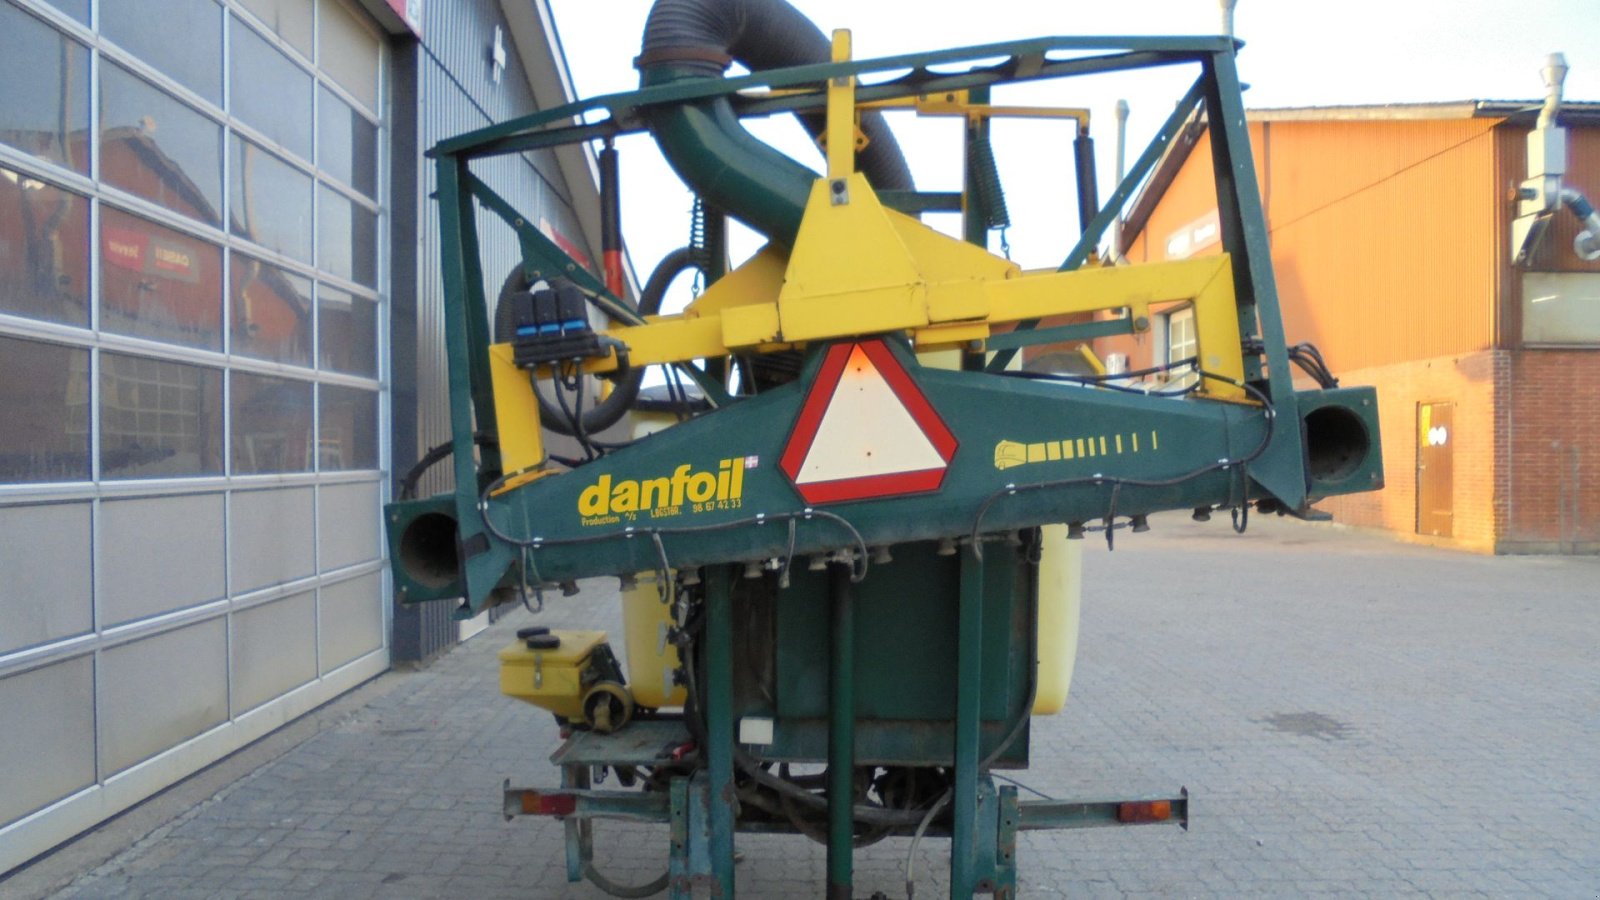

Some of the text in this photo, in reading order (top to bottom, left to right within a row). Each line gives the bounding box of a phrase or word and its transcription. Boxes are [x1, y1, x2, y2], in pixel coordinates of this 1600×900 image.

[578, 457, 744, 516] danfoil
[581, 515, 620, 526] Production
[717, 500, 729, 510] 42
[731, 499, 742, 508] 33
